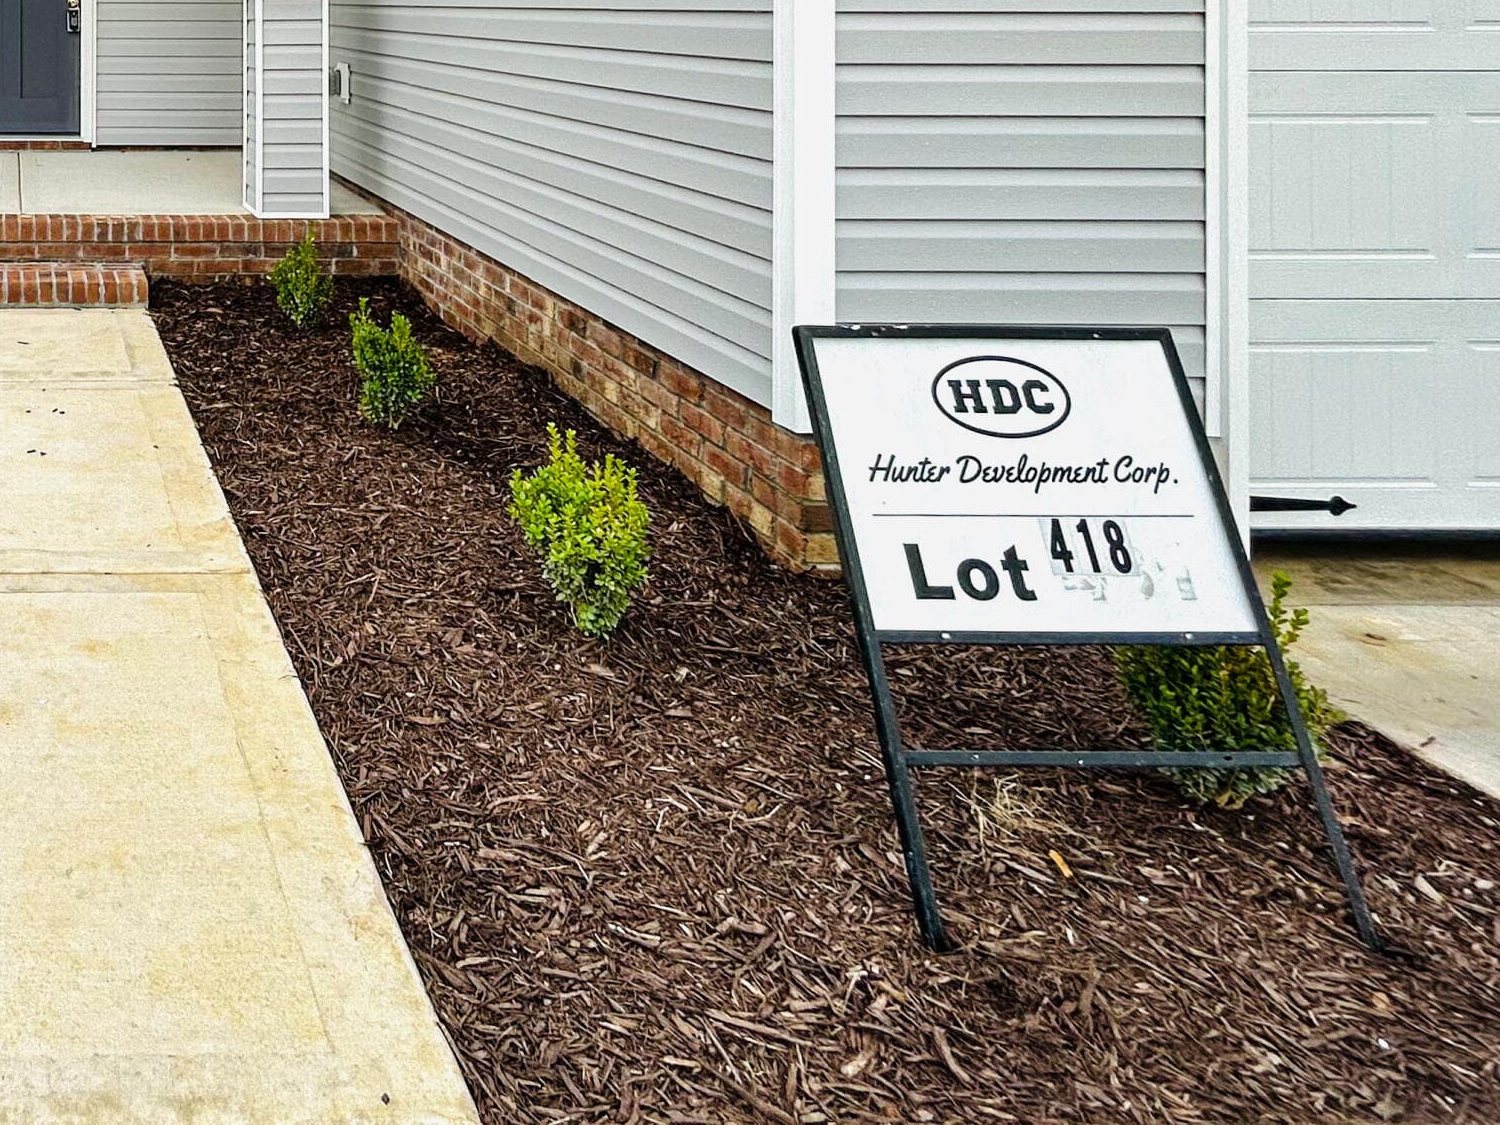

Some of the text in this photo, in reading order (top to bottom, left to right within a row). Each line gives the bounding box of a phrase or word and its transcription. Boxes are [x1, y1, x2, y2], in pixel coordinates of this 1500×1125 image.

[947, 379, 1056, 416] HDC
[868, 453, 1180, 494] Hunter Development Corp.
[903, 518, 1132, 601] Lot 418
